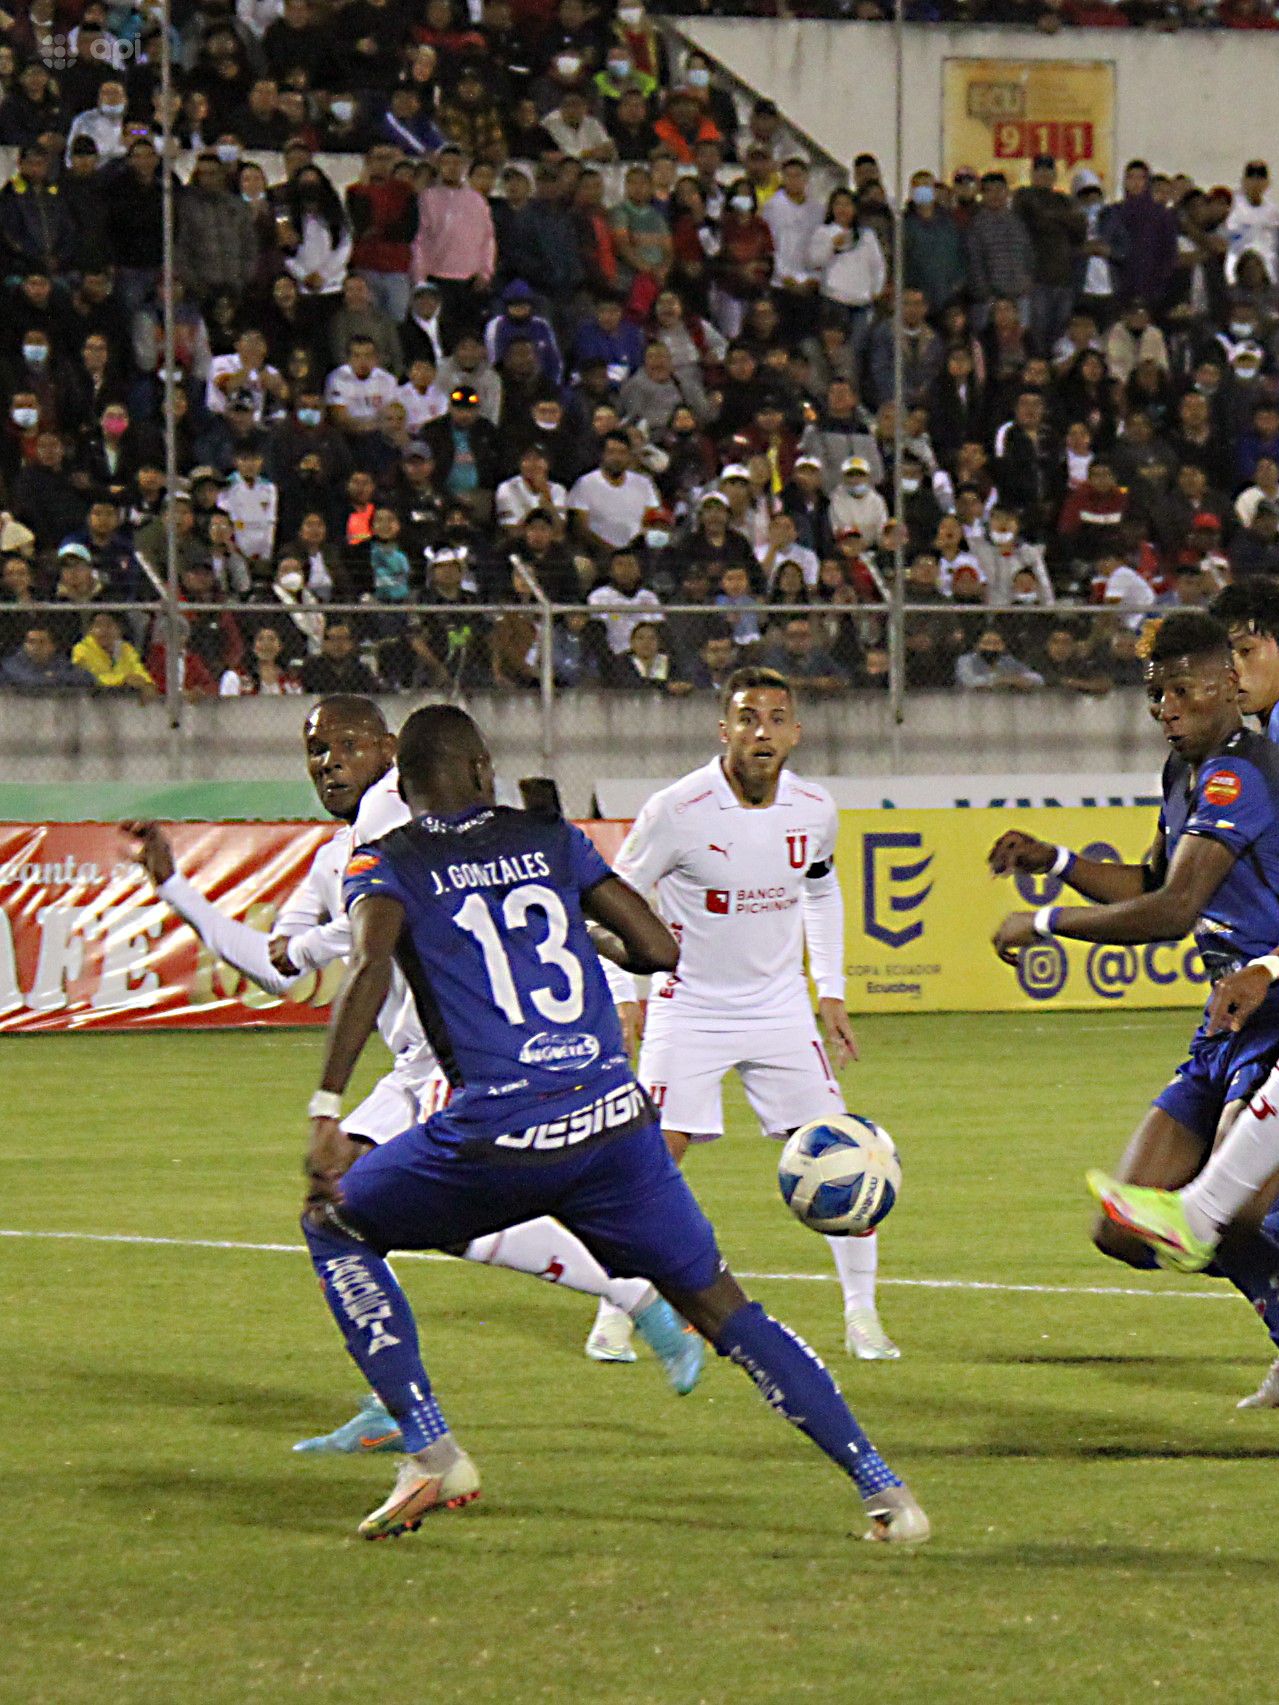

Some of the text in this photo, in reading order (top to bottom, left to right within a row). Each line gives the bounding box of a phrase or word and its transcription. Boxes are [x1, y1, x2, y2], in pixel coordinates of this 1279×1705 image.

[1001, 125, 1085, 155] 911
[786, 834, 808, 869] U
[430, 870, 450, 895] J.
[736, 887, 787, 901] BANCO
[452, 883, 585, 1026] 13
